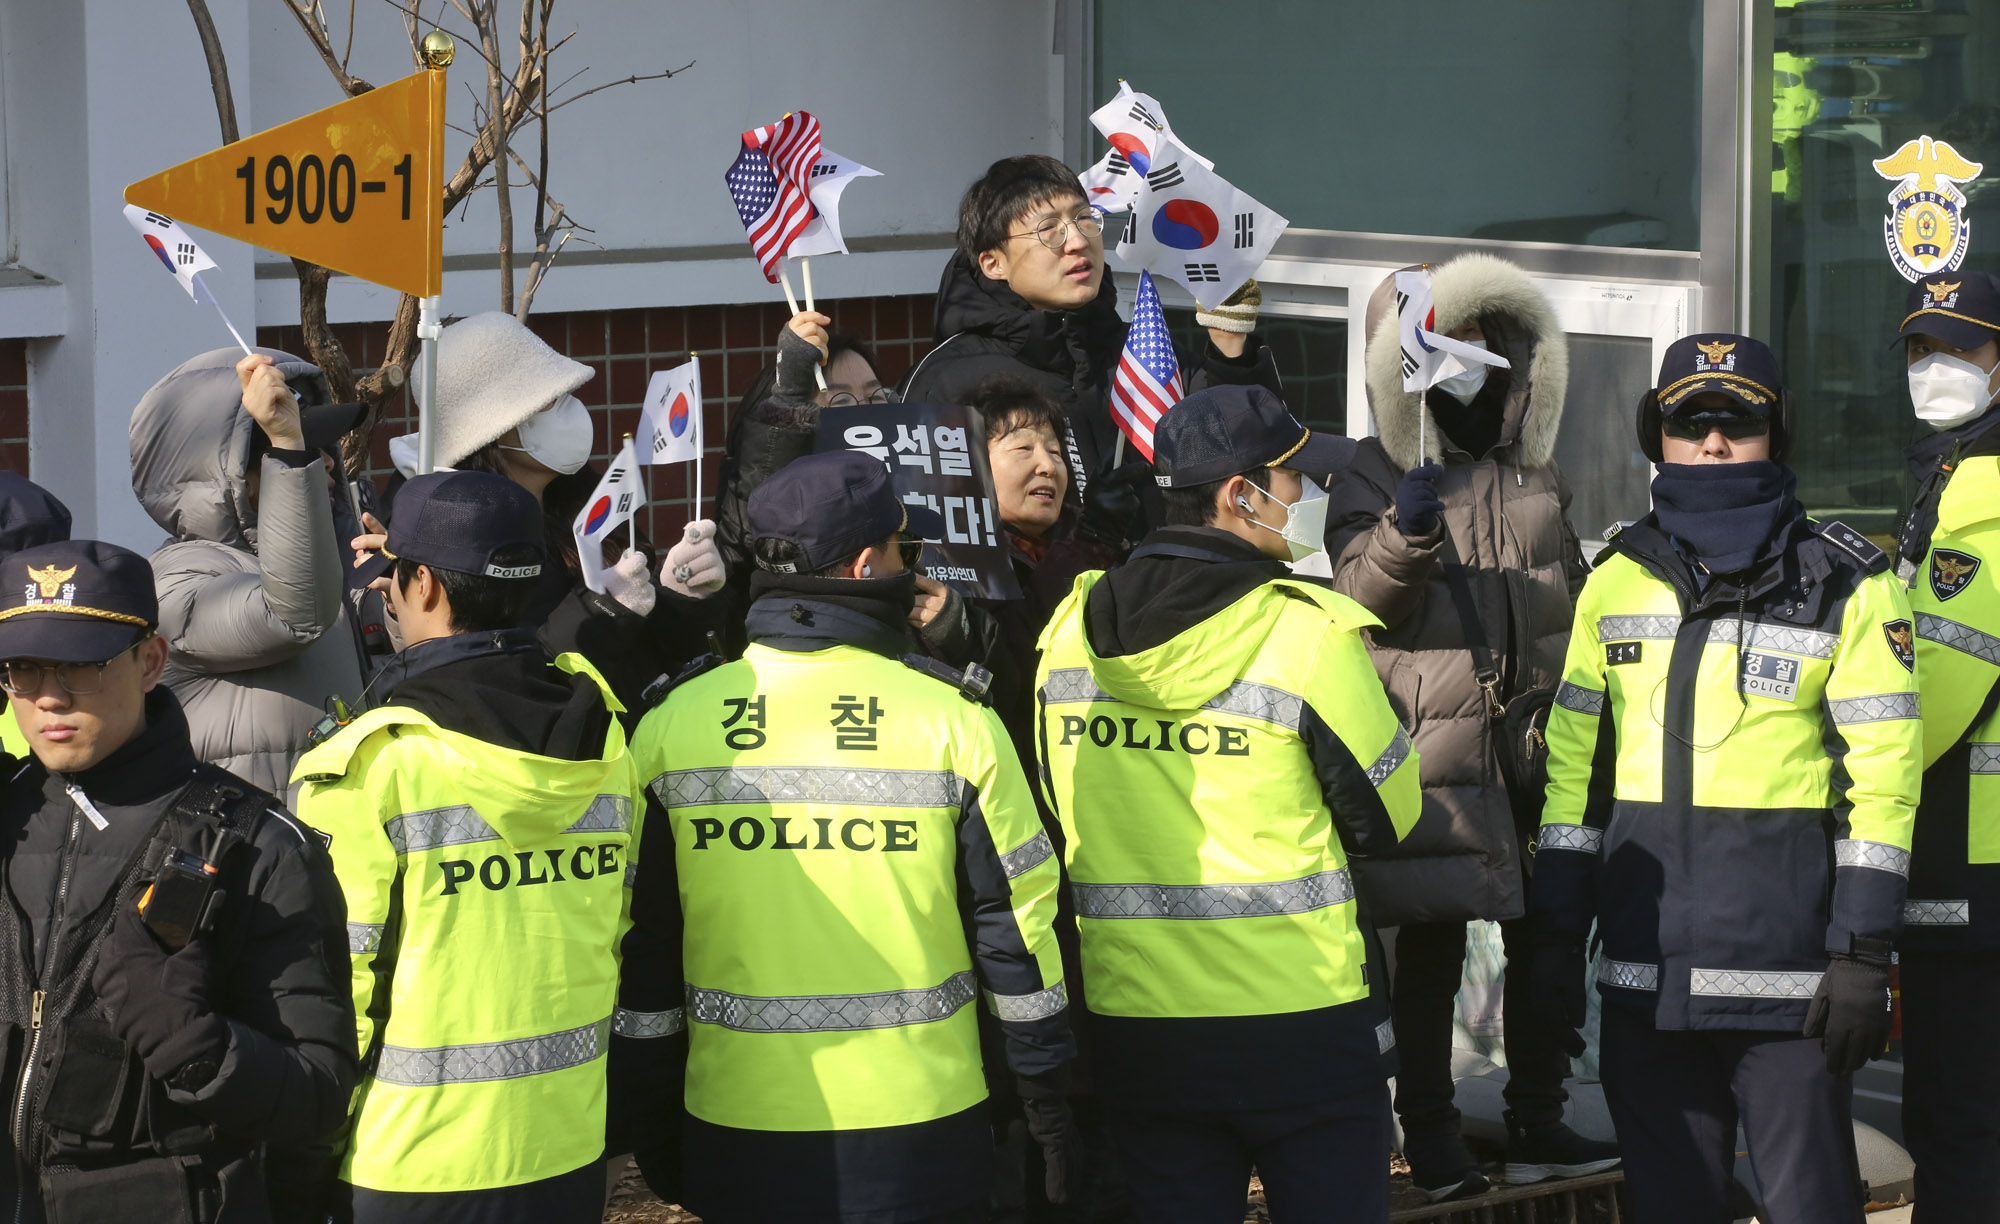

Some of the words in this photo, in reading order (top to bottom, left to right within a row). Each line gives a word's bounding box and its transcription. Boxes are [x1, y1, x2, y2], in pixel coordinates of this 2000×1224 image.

[236, 154, 411, 224] 1900-1
[492, 567, 537, 577] POLICE
[1936, 582, 1956, 592] POLICE
[1059, 715, 1250, 757] POLICE
[689, 816, 918, 852] POLICE
[438, 843, 624, 896] POLICE
